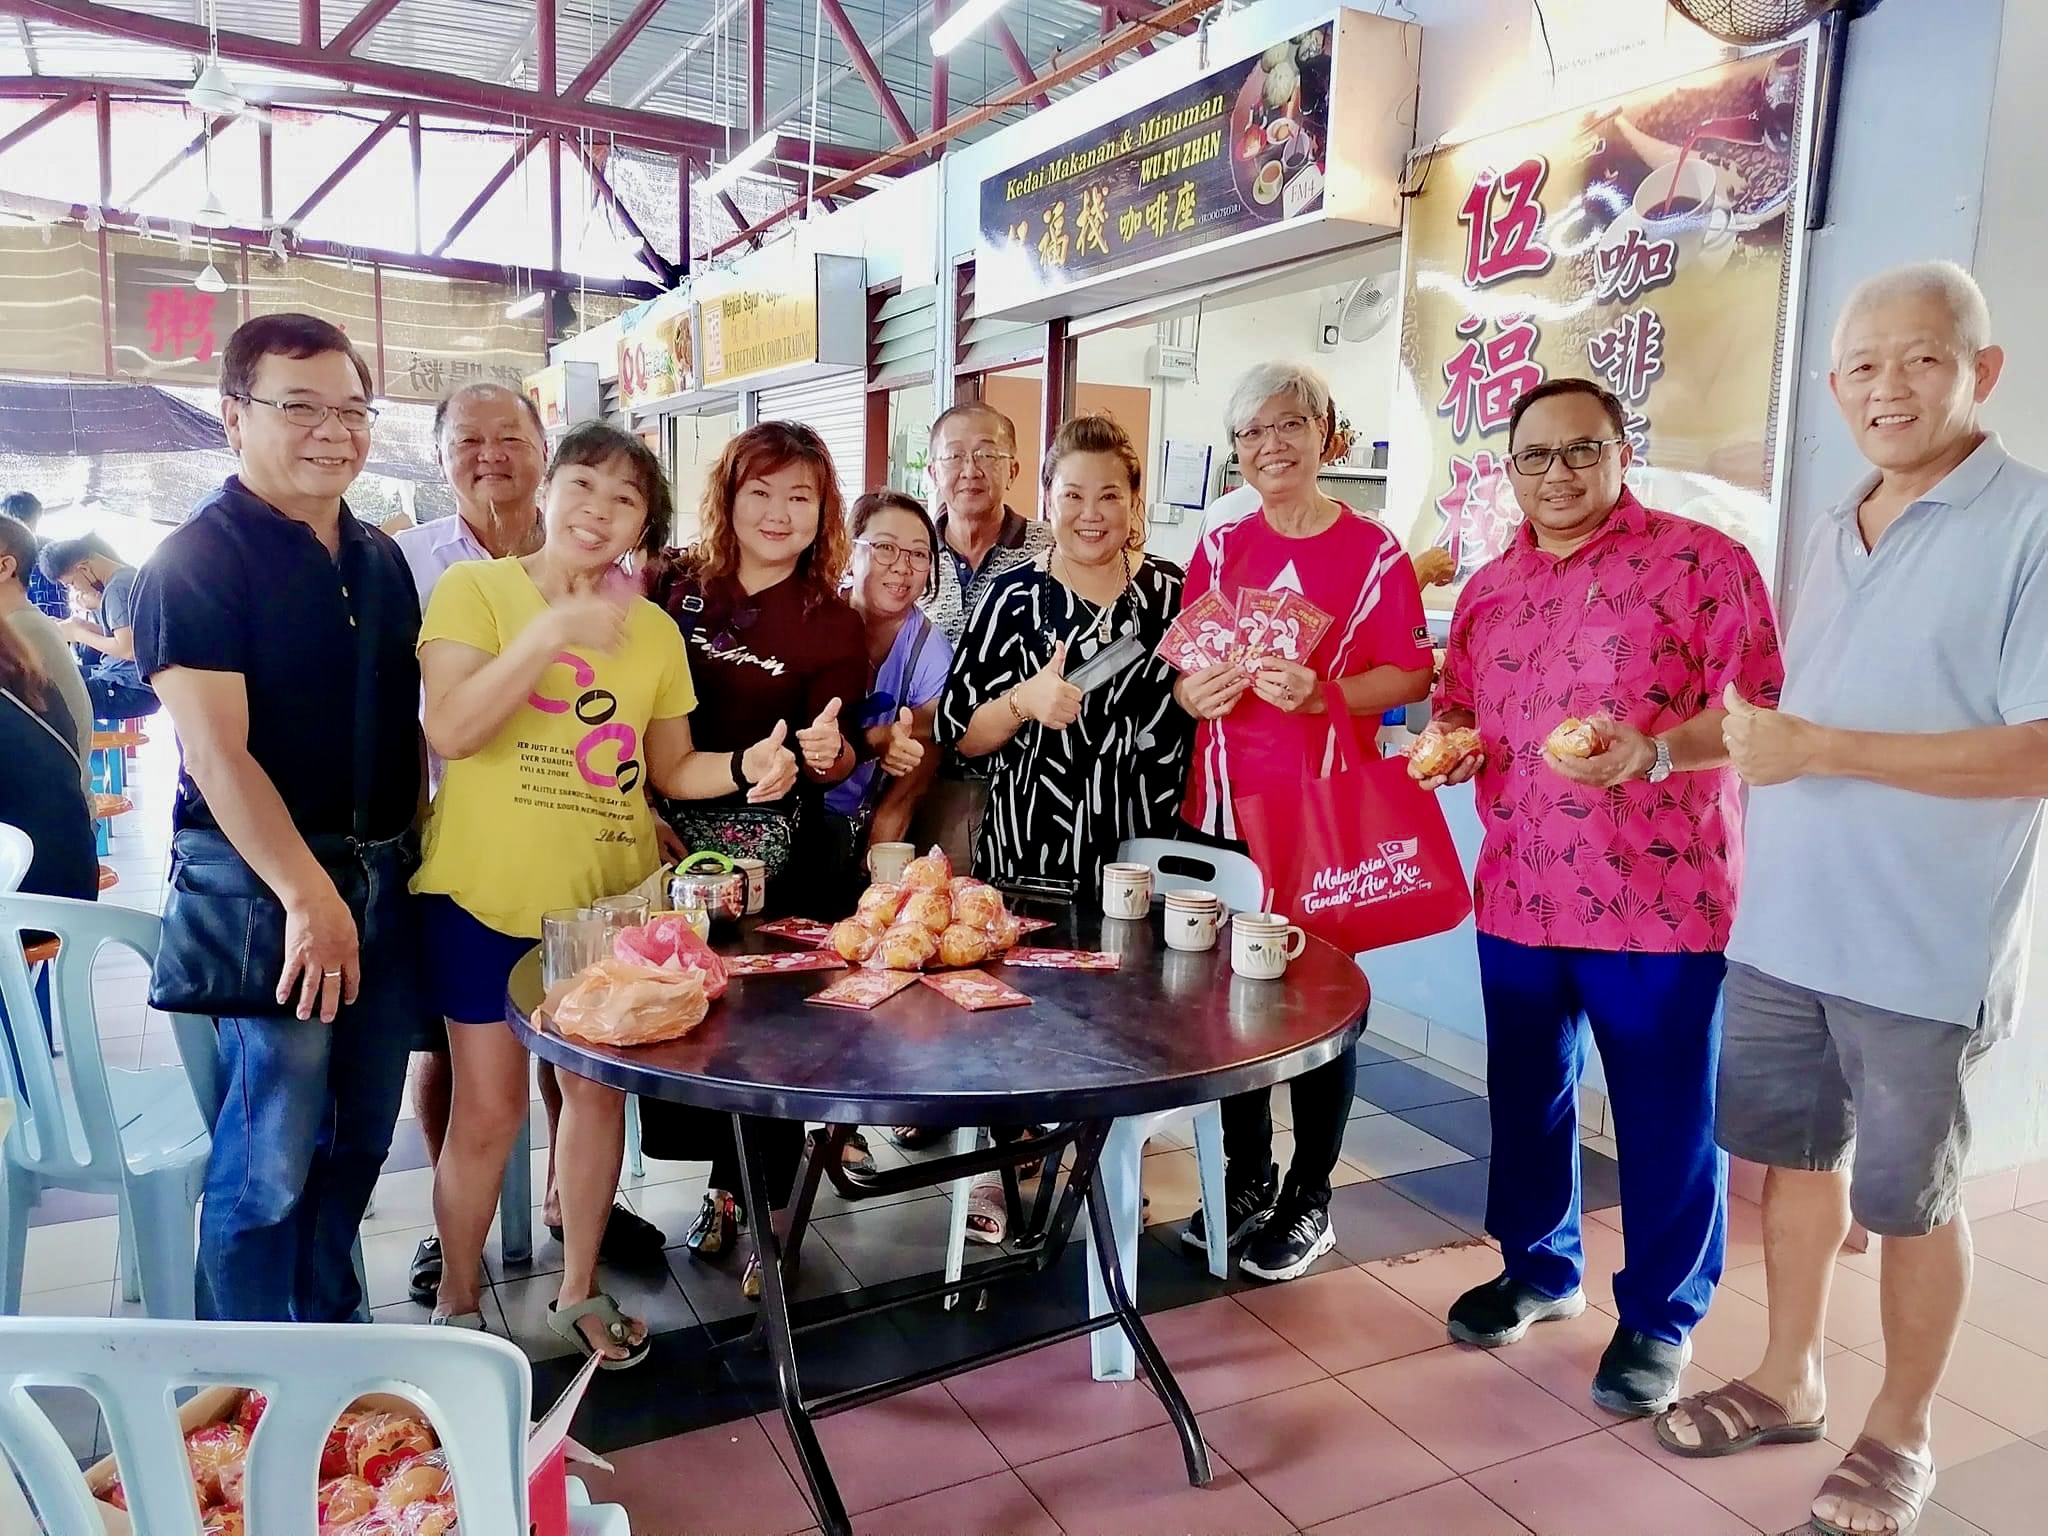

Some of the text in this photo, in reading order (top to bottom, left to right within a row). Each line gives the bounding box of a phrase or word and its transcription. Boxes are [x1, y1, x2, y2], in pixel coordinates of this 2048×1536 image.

[1005, 94, 1224, 202] Kedai Makanan & Minuman
[1139, 129, 1222, 185] WU FU ZHAN
[1119, 180, 1198, 244] 咖啡座
[145, 287, 216, 362] 粥
[1301, 887, 1352, 914] Tanah
[1357, 873, 1389, 899] Air
[1393, 863, 1421, 886] Ku
[1312, 857, 1386, 893] Malaysia
